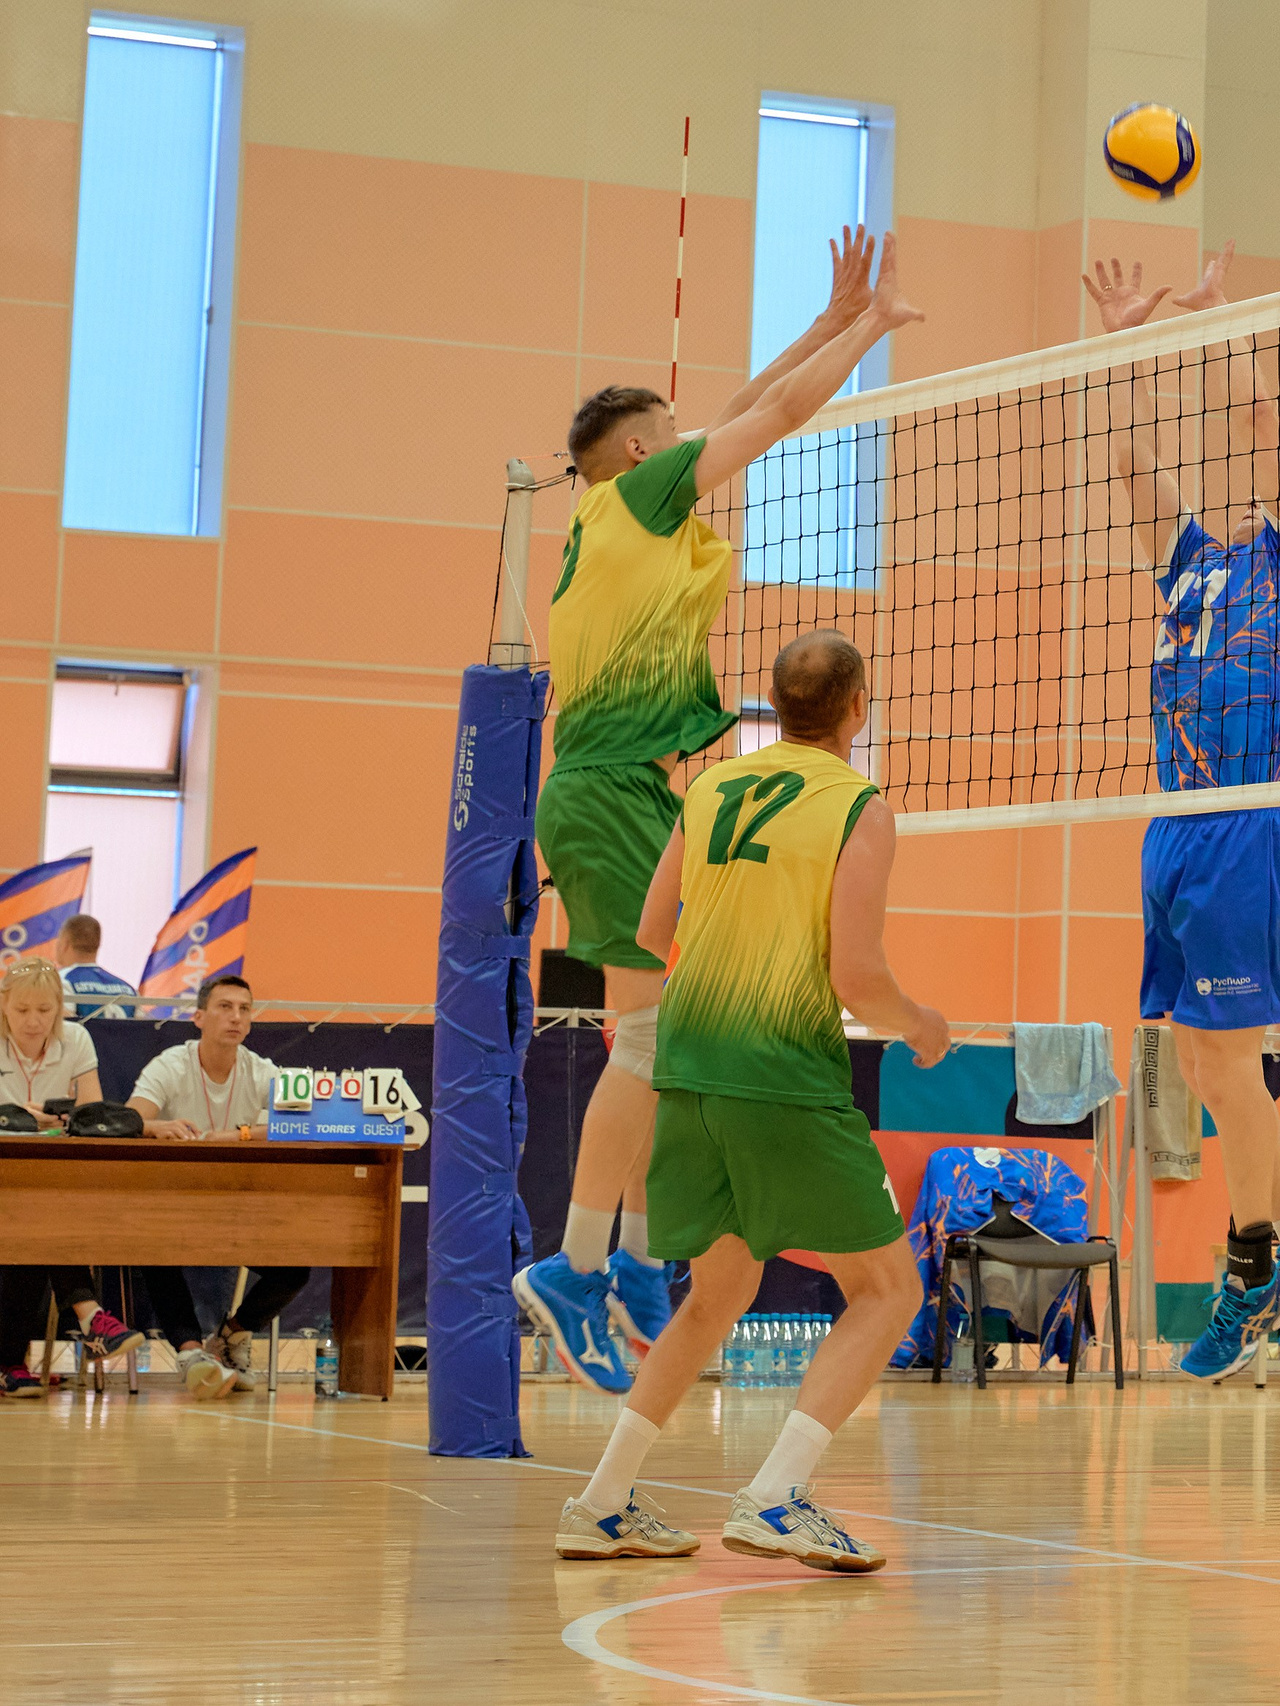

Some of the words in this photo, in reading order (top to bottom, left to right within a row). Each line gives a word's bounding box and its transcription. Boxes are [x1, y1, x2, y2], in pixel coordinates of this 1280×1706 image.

[707, 771, 805, 865] 12
[280, 1074, 310, 1101] 10
[370, 1076, 400, 1105] 16
[270, 1122, 310, 1135] HOME
[316, 1124, 356, 1134] TORRES
[363, 1124, 402, 1136] GUEST
